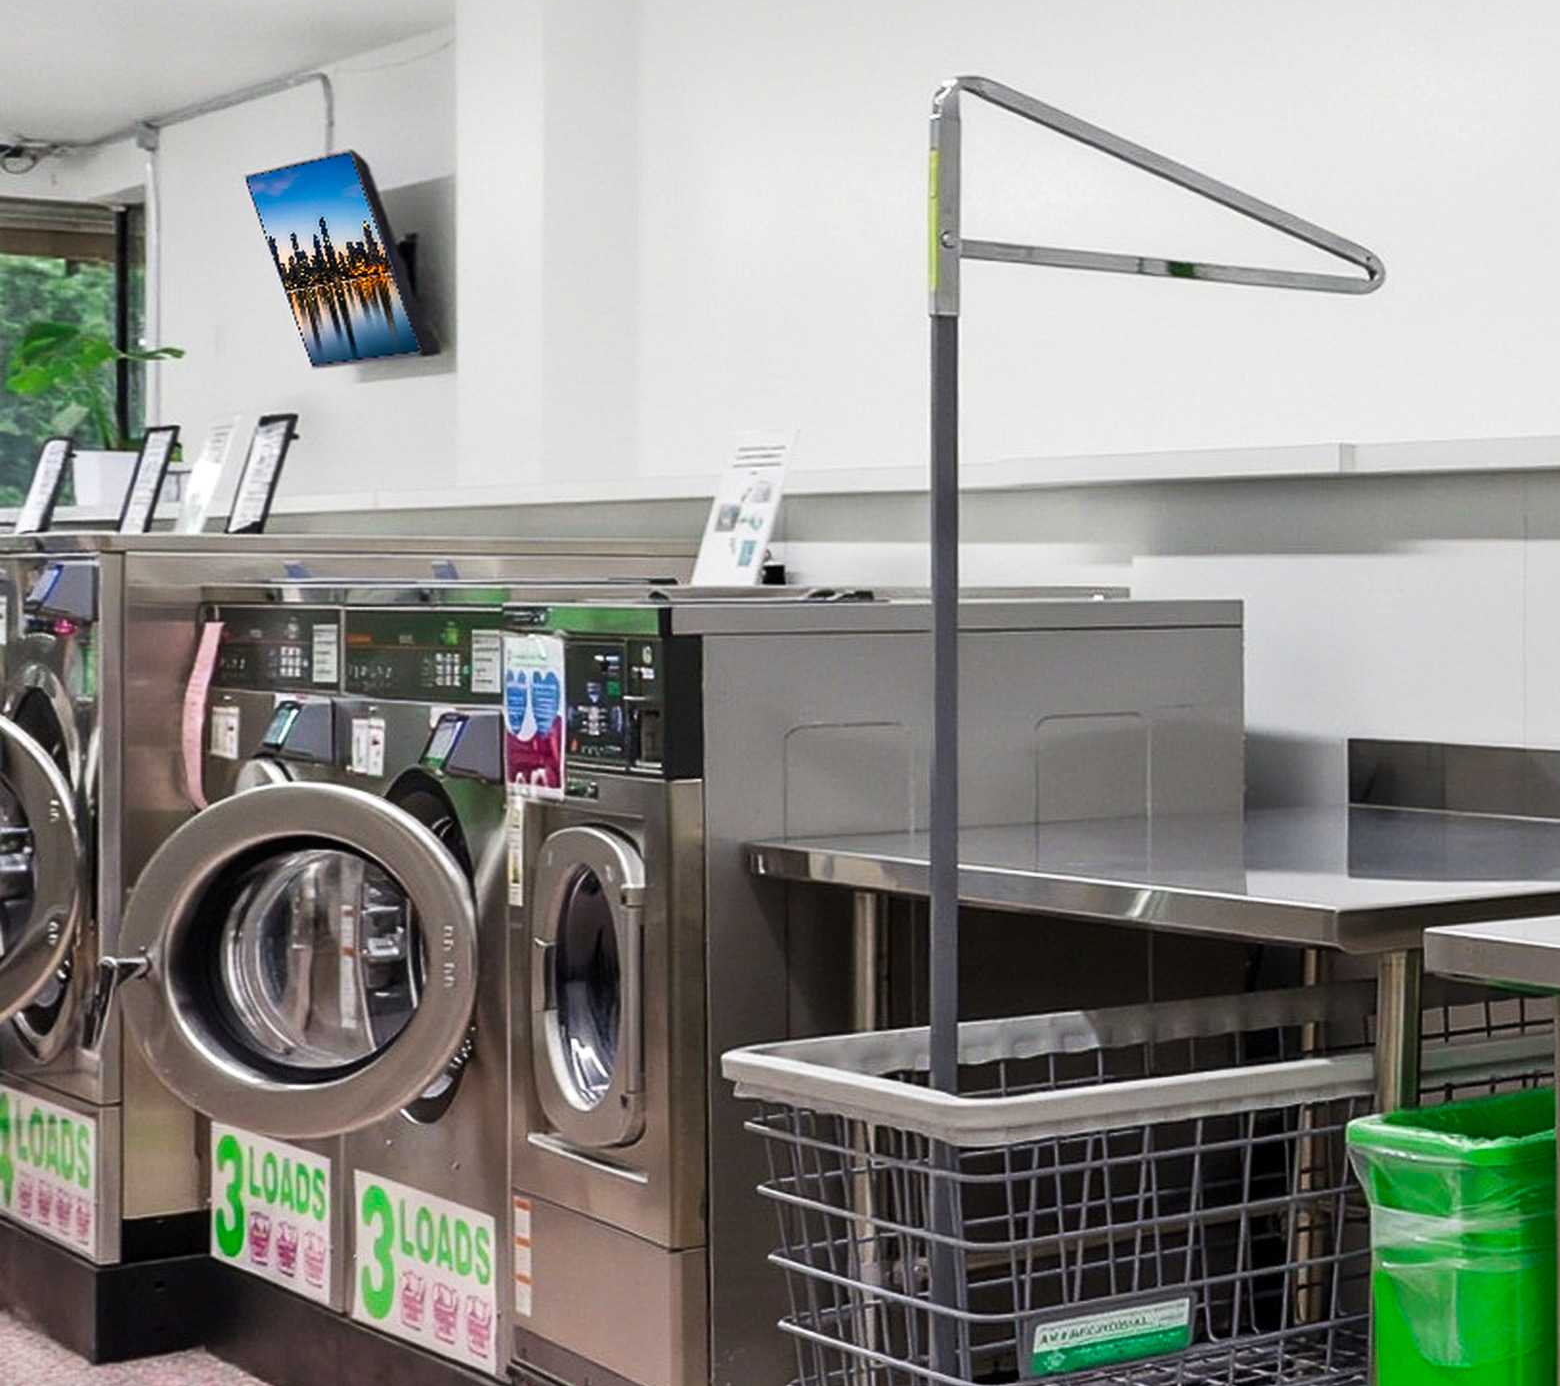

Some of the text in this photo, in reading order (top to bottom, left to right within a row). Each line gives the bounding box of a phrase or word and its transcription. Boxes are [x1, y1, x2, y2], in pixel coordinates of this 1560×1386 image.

[15, 1097, 91, 1190] LOADS
[215, 1134, 326, 1258] 3 LOADS
[361, 1185, 490, 1319] 3 LOADS
